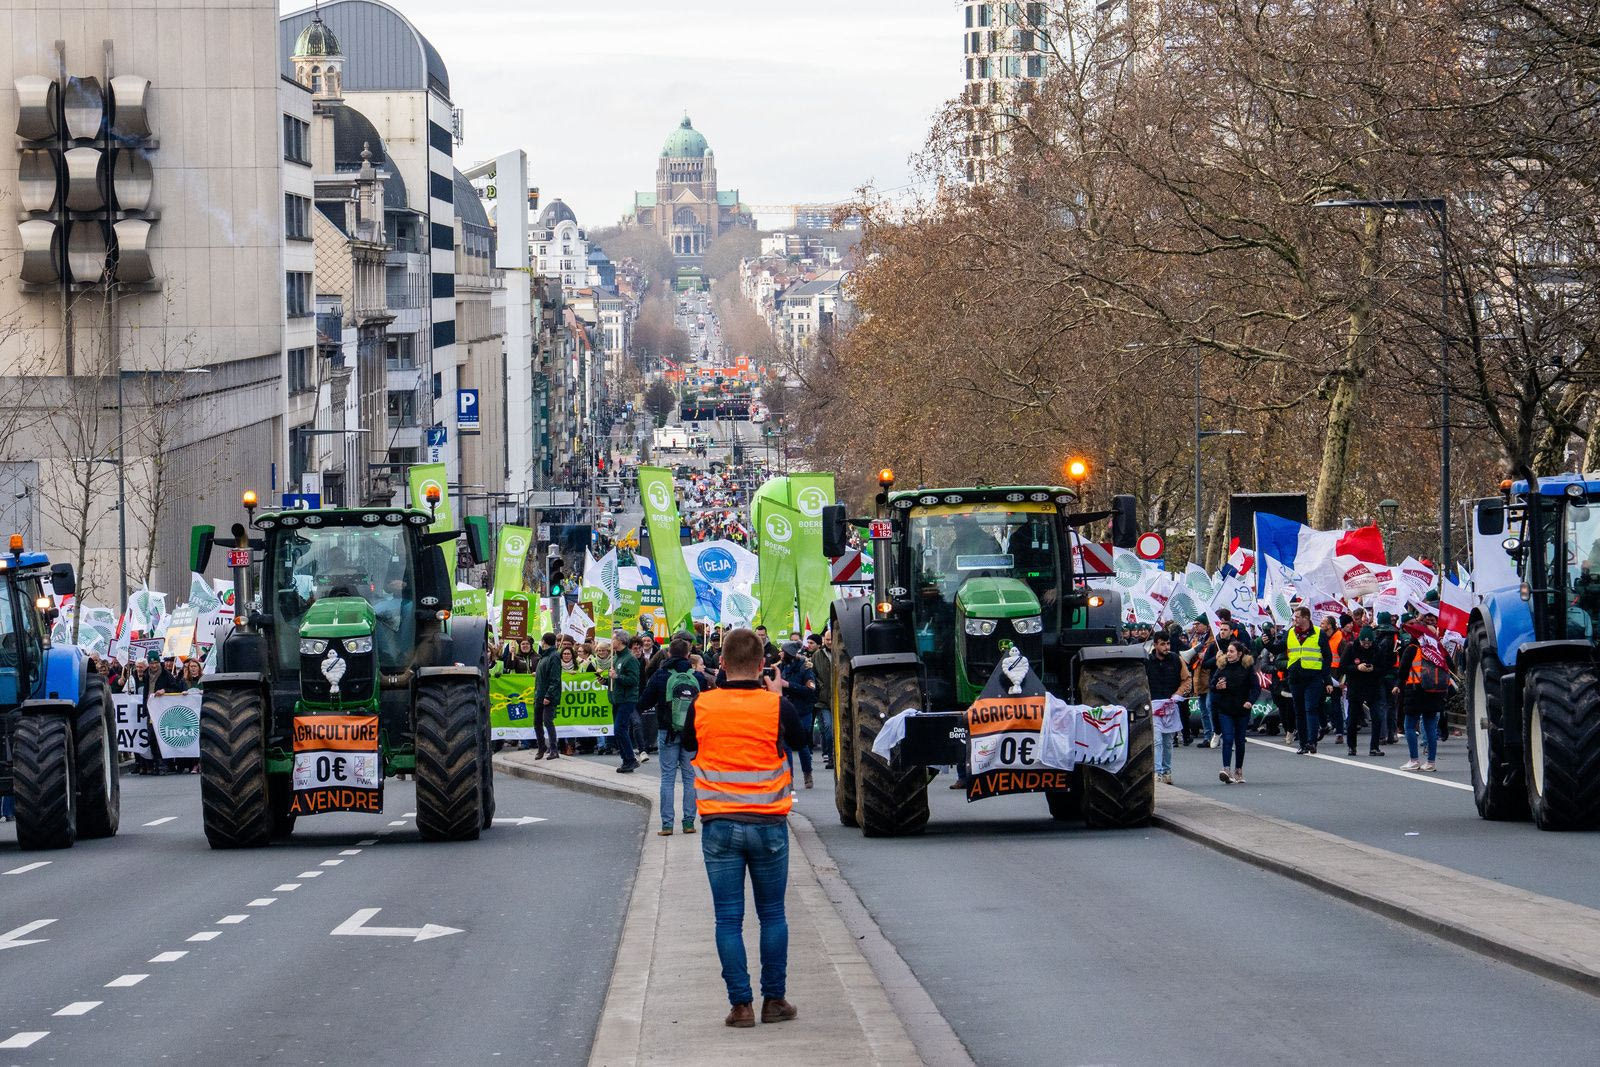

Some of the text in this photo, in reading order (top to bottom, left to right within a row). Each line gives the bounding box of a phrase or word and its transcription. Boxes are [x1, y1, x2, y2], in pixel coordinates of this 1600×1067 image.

[461, 393, 476, 413] P
[704, 559, 732, 572] CEJA
[452, 598, 472, 608] LOCK
[561, 681, 609, 692] NLOC
[565, 693, 597, 705] OUR
[115, 704, 129, 723] E
[555, 705, 609, 718] FUTURE
[293, 724, 377, 743] AGRICULTURE
[1000, 737, 1036, 765] 0€
[316, 756, 348, 782] 0€
[970, 772, 1067, 798] A VENDRE
[290, 790, 380, 813] A VENDRE
